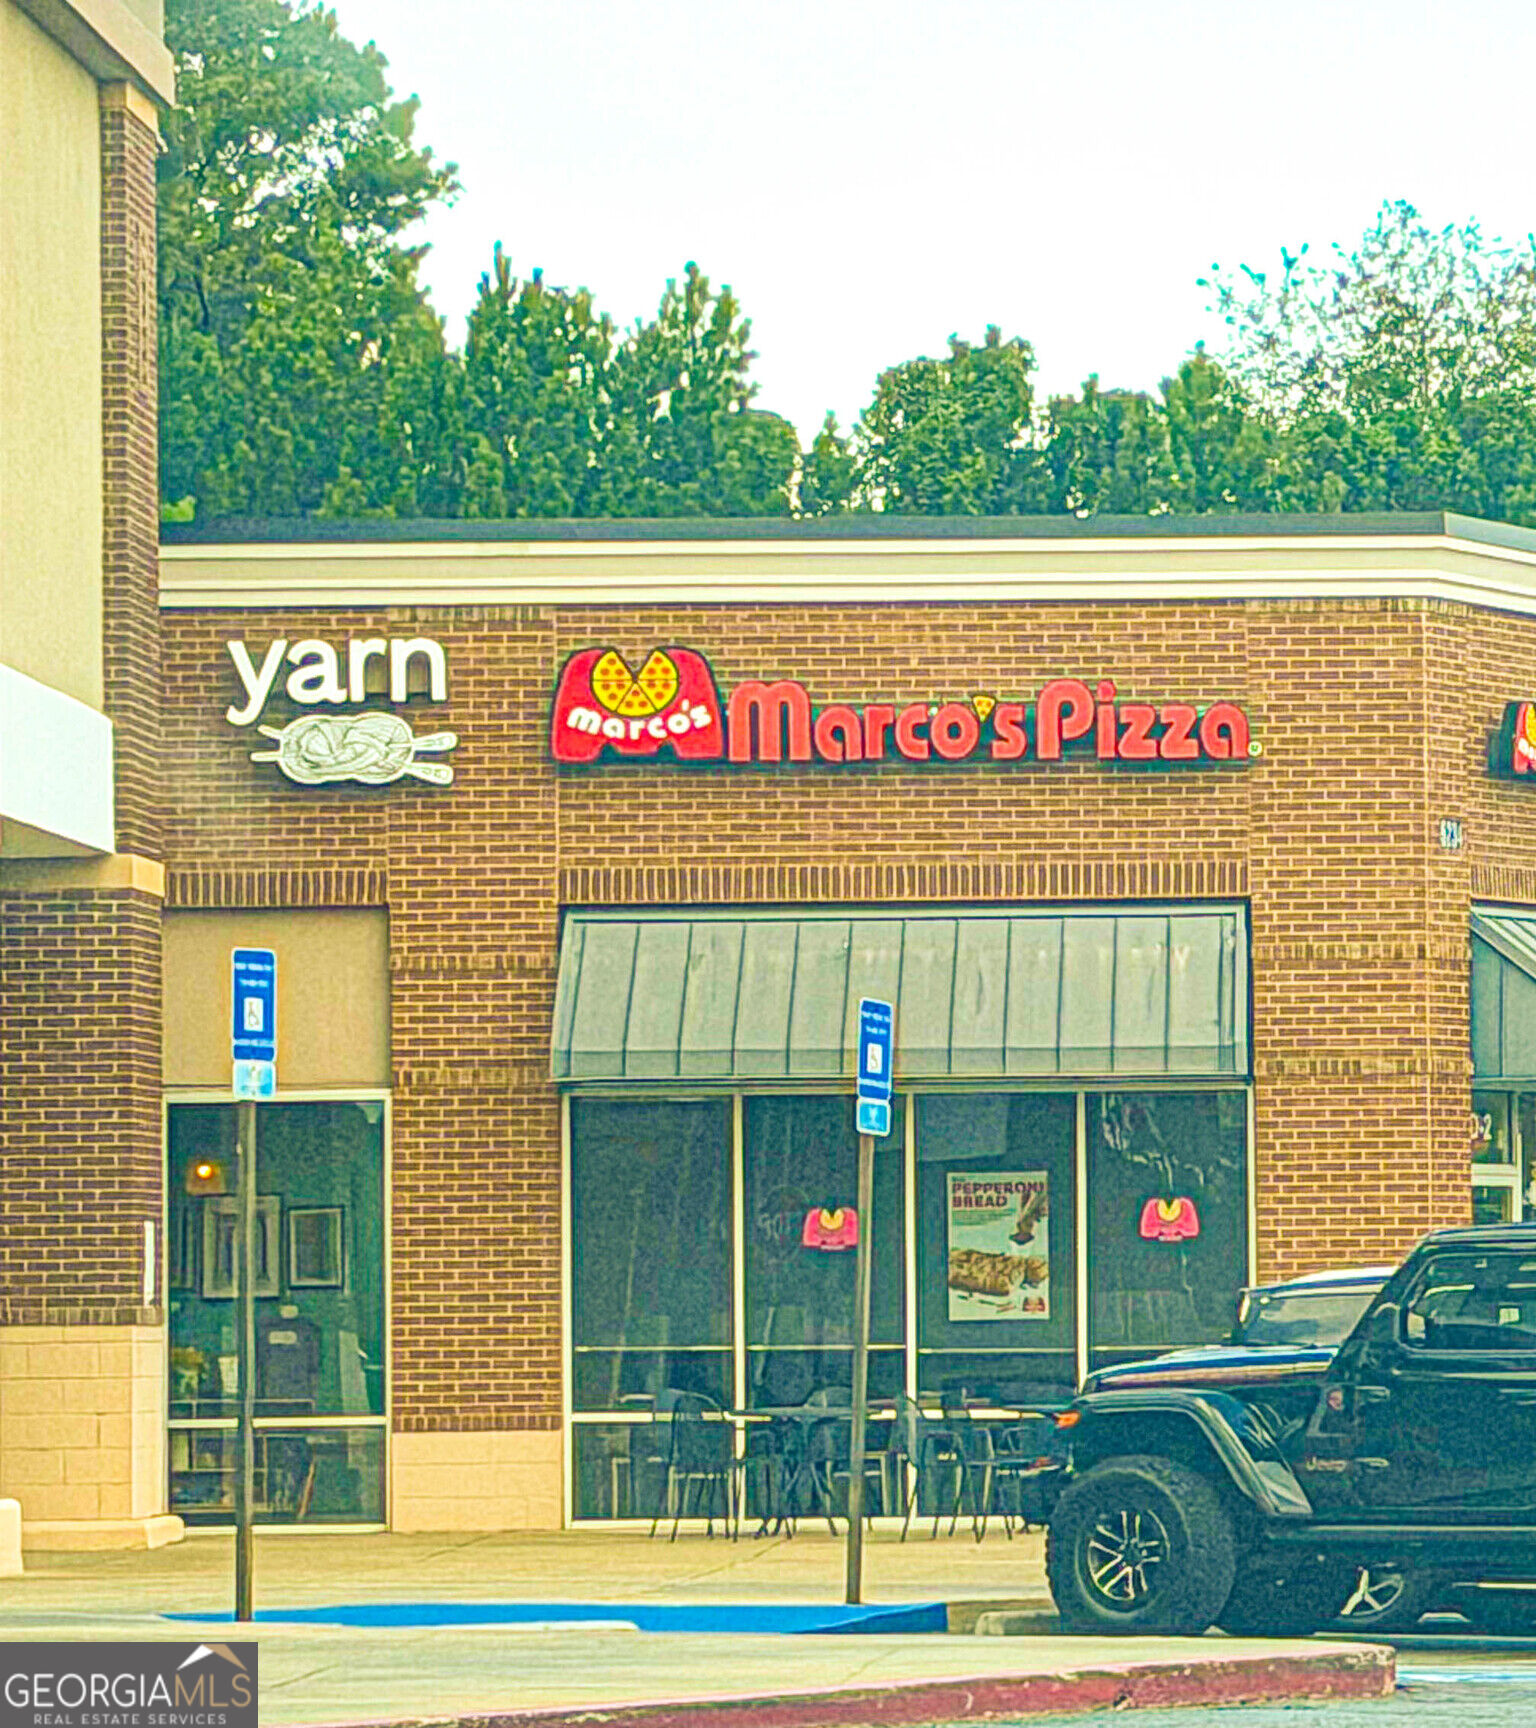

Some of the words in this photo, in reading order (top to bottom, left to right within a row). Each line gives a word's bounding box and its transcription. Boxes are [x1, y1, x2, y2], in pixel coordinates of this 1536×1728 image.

[226, 638, 448, 727] yarn
[727, 679, 1028, 763] Marco's
[1036, 677, 1251, 762] Pizza
[952, 1181, 1045, 1194] PEPPERONI
[952, 1195, 1008, 1208] BREAD
